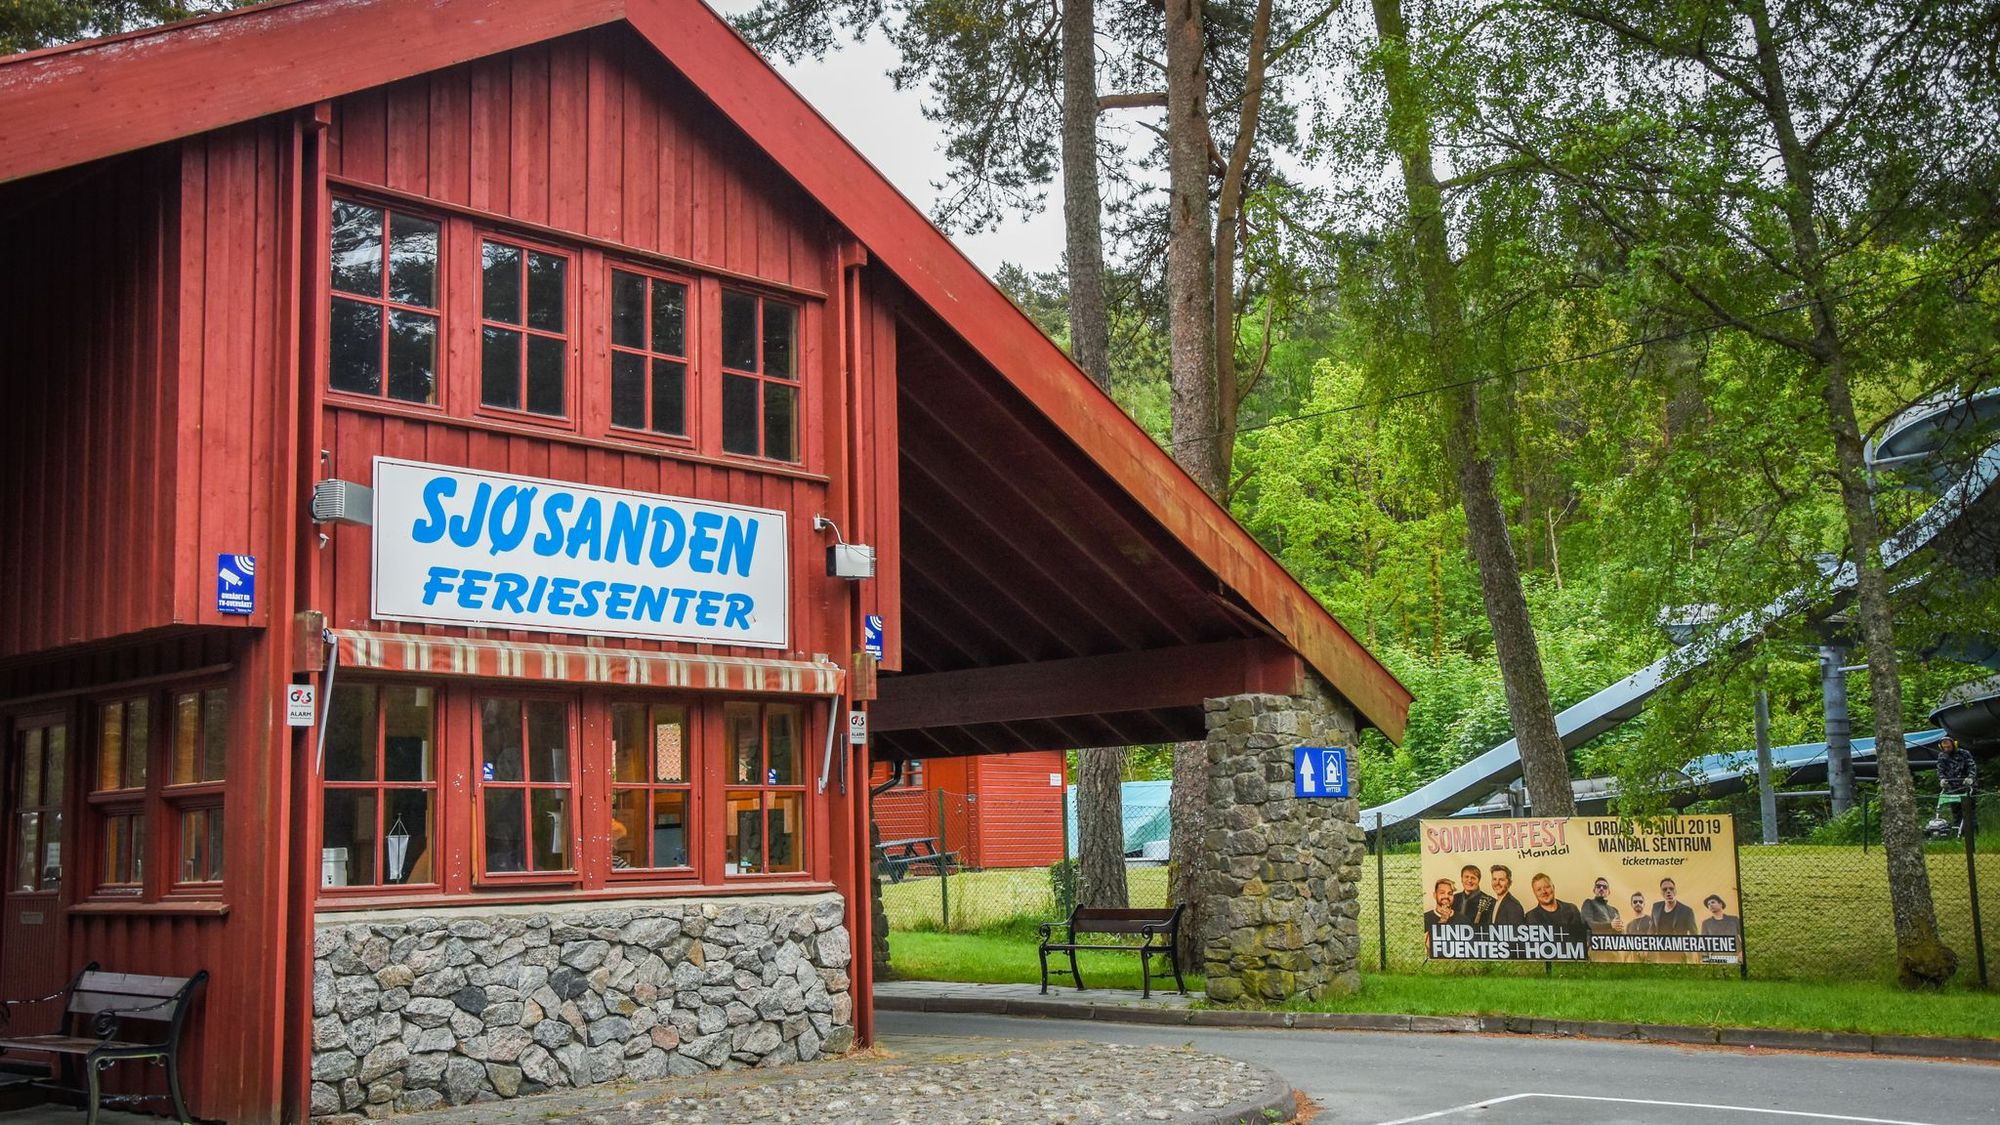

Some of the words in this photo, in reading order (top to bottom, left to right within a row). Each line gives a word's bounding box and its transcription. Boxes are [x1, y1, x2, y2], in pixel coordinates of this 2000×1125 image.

[412, 476, 759, 578] SJØSANDEN
[422, 566, 756, 630] FERIESENTER
[1688, 819, 1721, 834] 2019
[1426, 819, 1568, 854] SOMMERFEST
[1598, 837, 1649, 853] MANDAL
[1652, 836, 1711, 852] SENTRUM
[1622, 856, 1685, 866] ticketmaster
[1591, 935, 1736, 952] STAVANGERKAMERATENE
